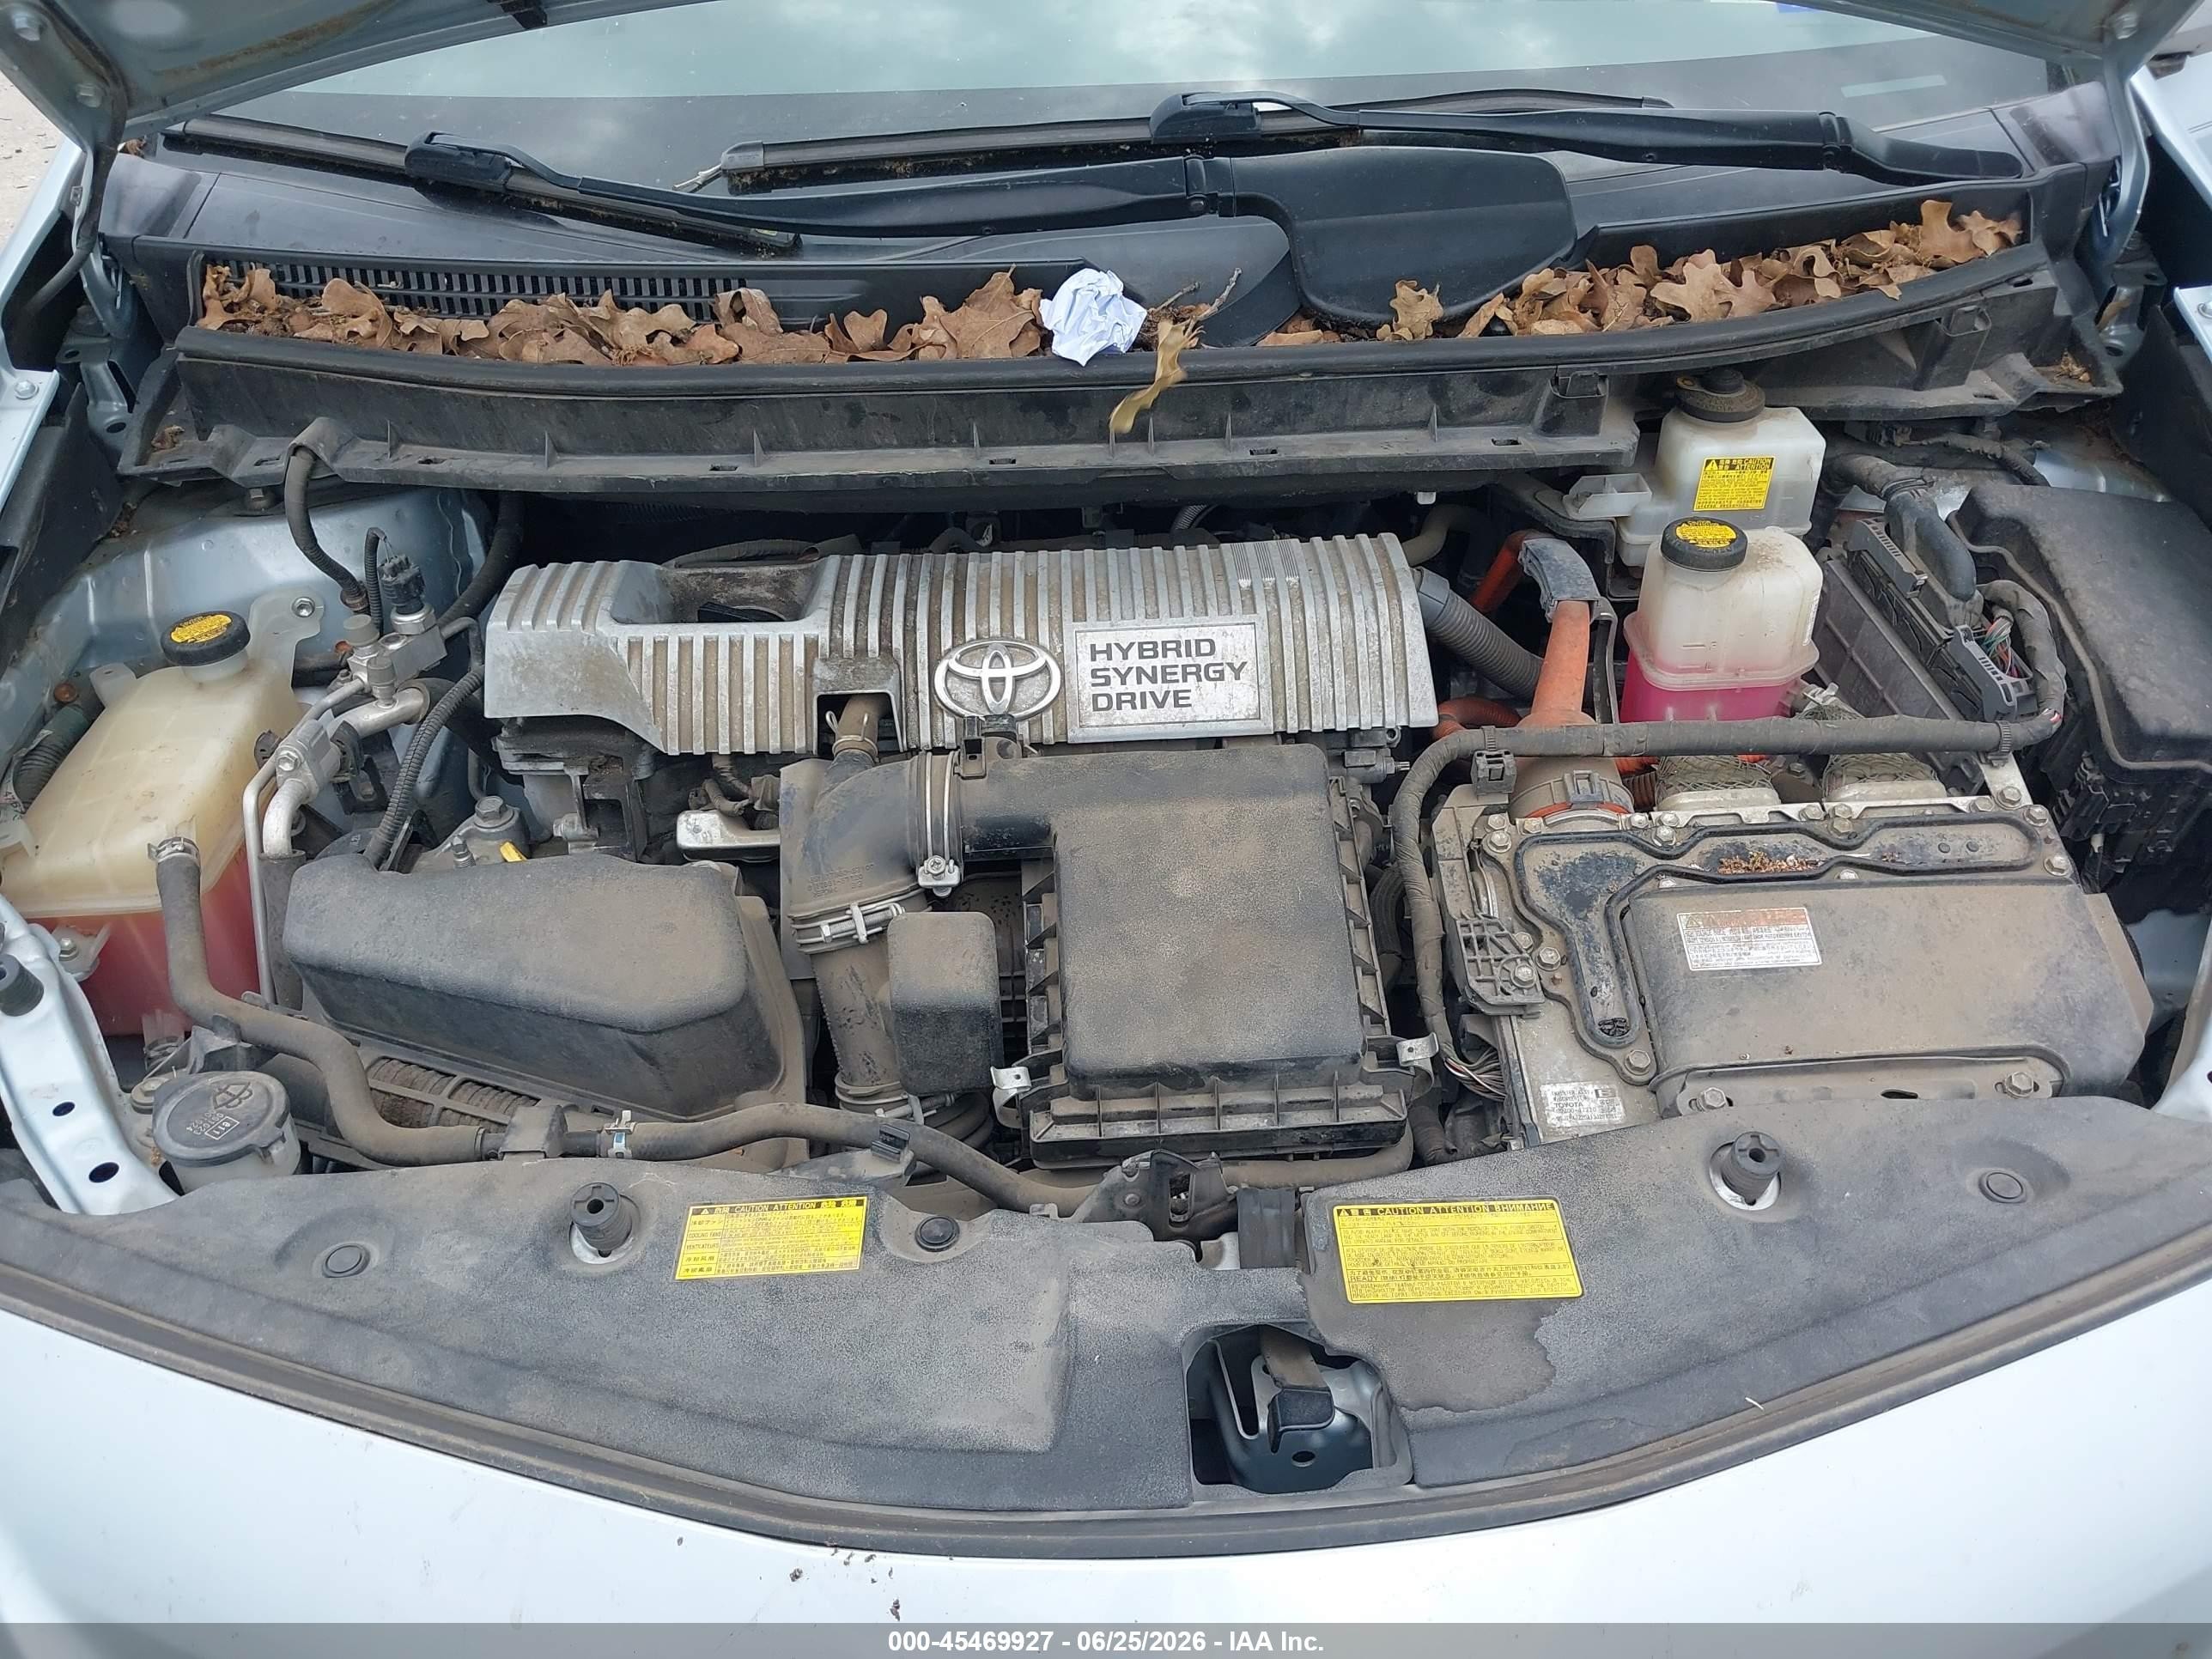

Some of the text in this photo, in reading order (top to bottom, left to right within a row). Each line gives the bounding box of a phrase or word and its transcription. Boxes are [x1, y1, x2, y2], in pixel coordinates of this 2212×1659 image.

[1090, 638, 1216, 661] HYBRID
[1091, 661, 1248, 687] SYNERGY
[1091, 690, 1192, 712] DRIVE
[735, 1201, 817, 1212] CAUTION ATTENTION
[1377, 1206, 1424, 1215] CAUTION
[1430, 1204, 1490, 1213] ATTENTION
[1494, 1203, 1552, 1212] ВНИМАНИЕ
